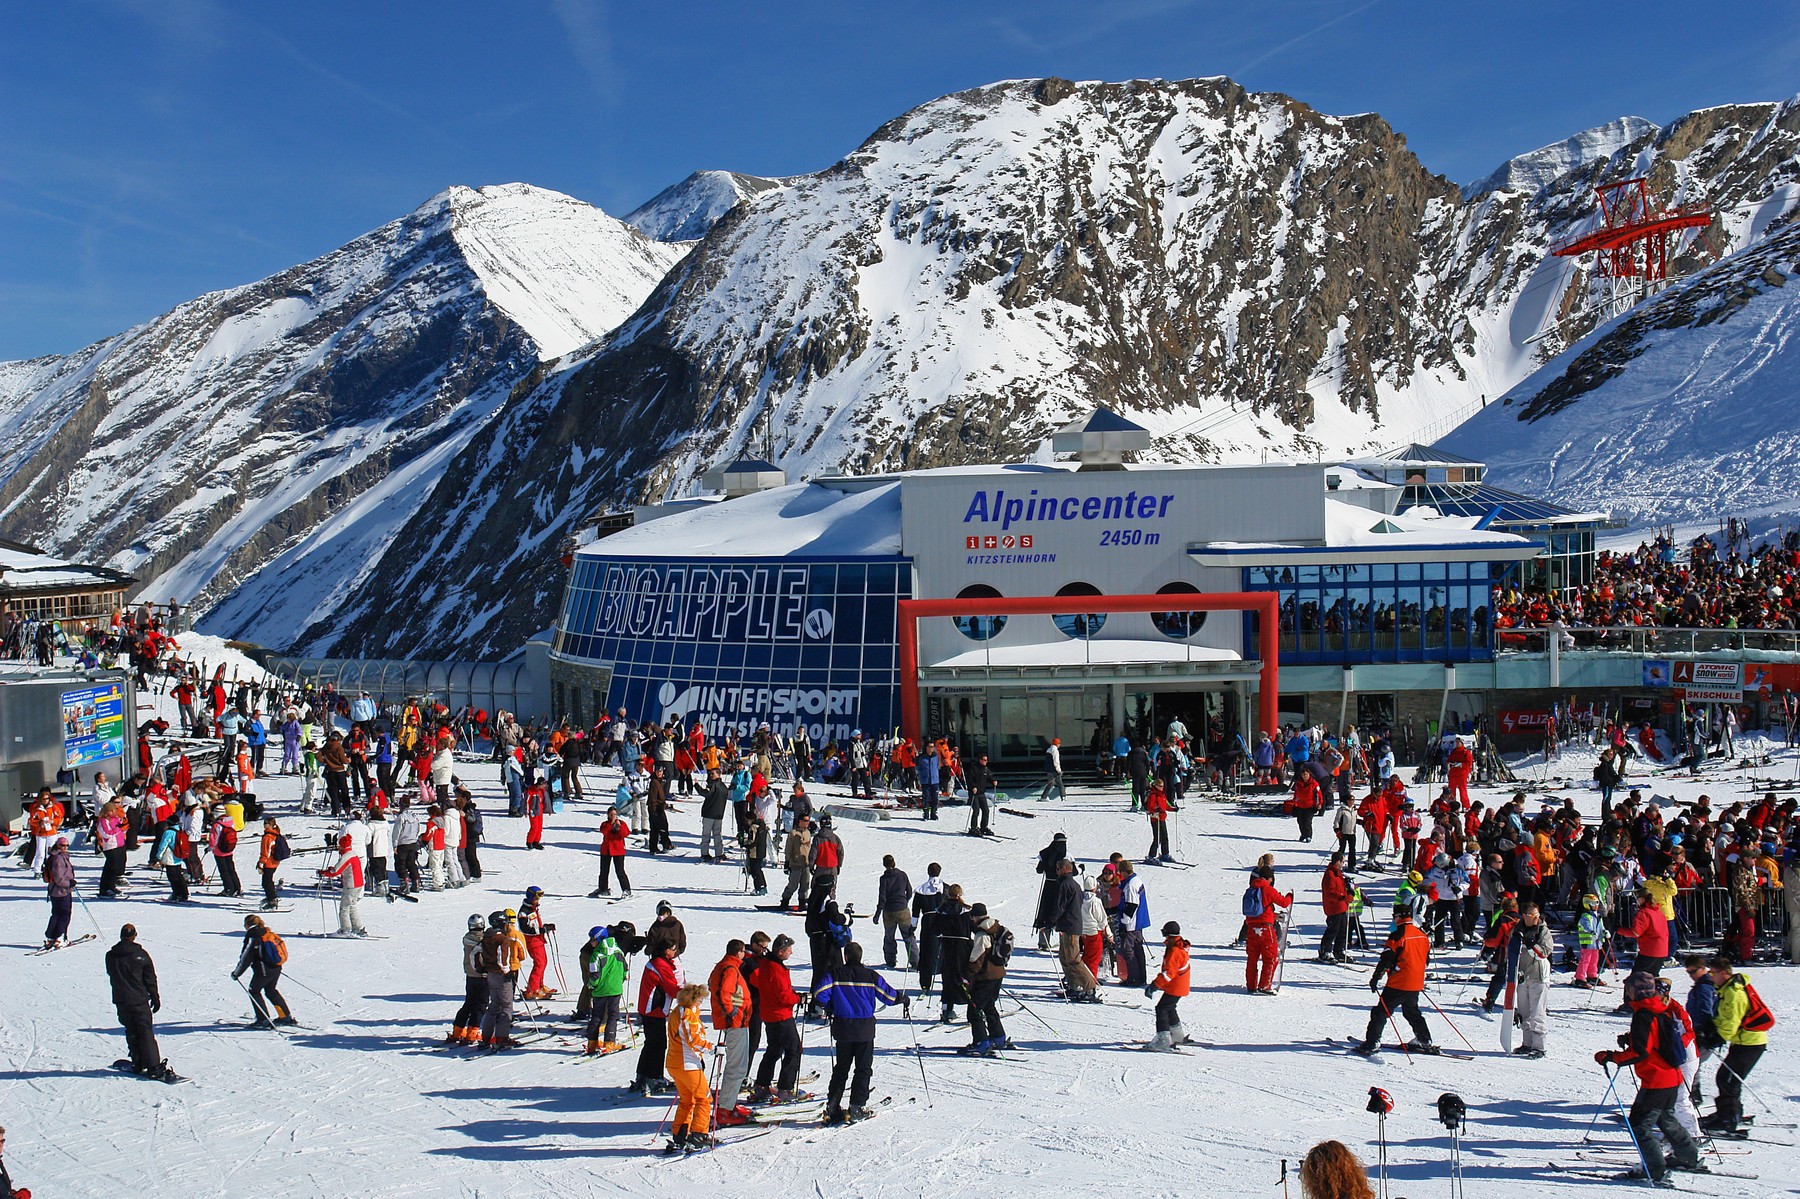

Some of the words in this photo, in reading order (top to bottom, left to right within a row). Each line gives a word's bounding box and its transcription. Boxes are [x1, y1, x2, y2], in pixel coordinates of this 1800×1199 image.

[964, 489, 1174, 531] Alpincenter
[1100, 530, 1142, 547] 2450
[1144, 532, 1160, 545] m
[967, 554, 1056, 565] KITZSTEINHORN
[699, 686, 859, 715] INTERSPORT
[1687, 691, 1742, 700] SKISCHULE
[699, 713, 850, 740] Kitzstinhorn
